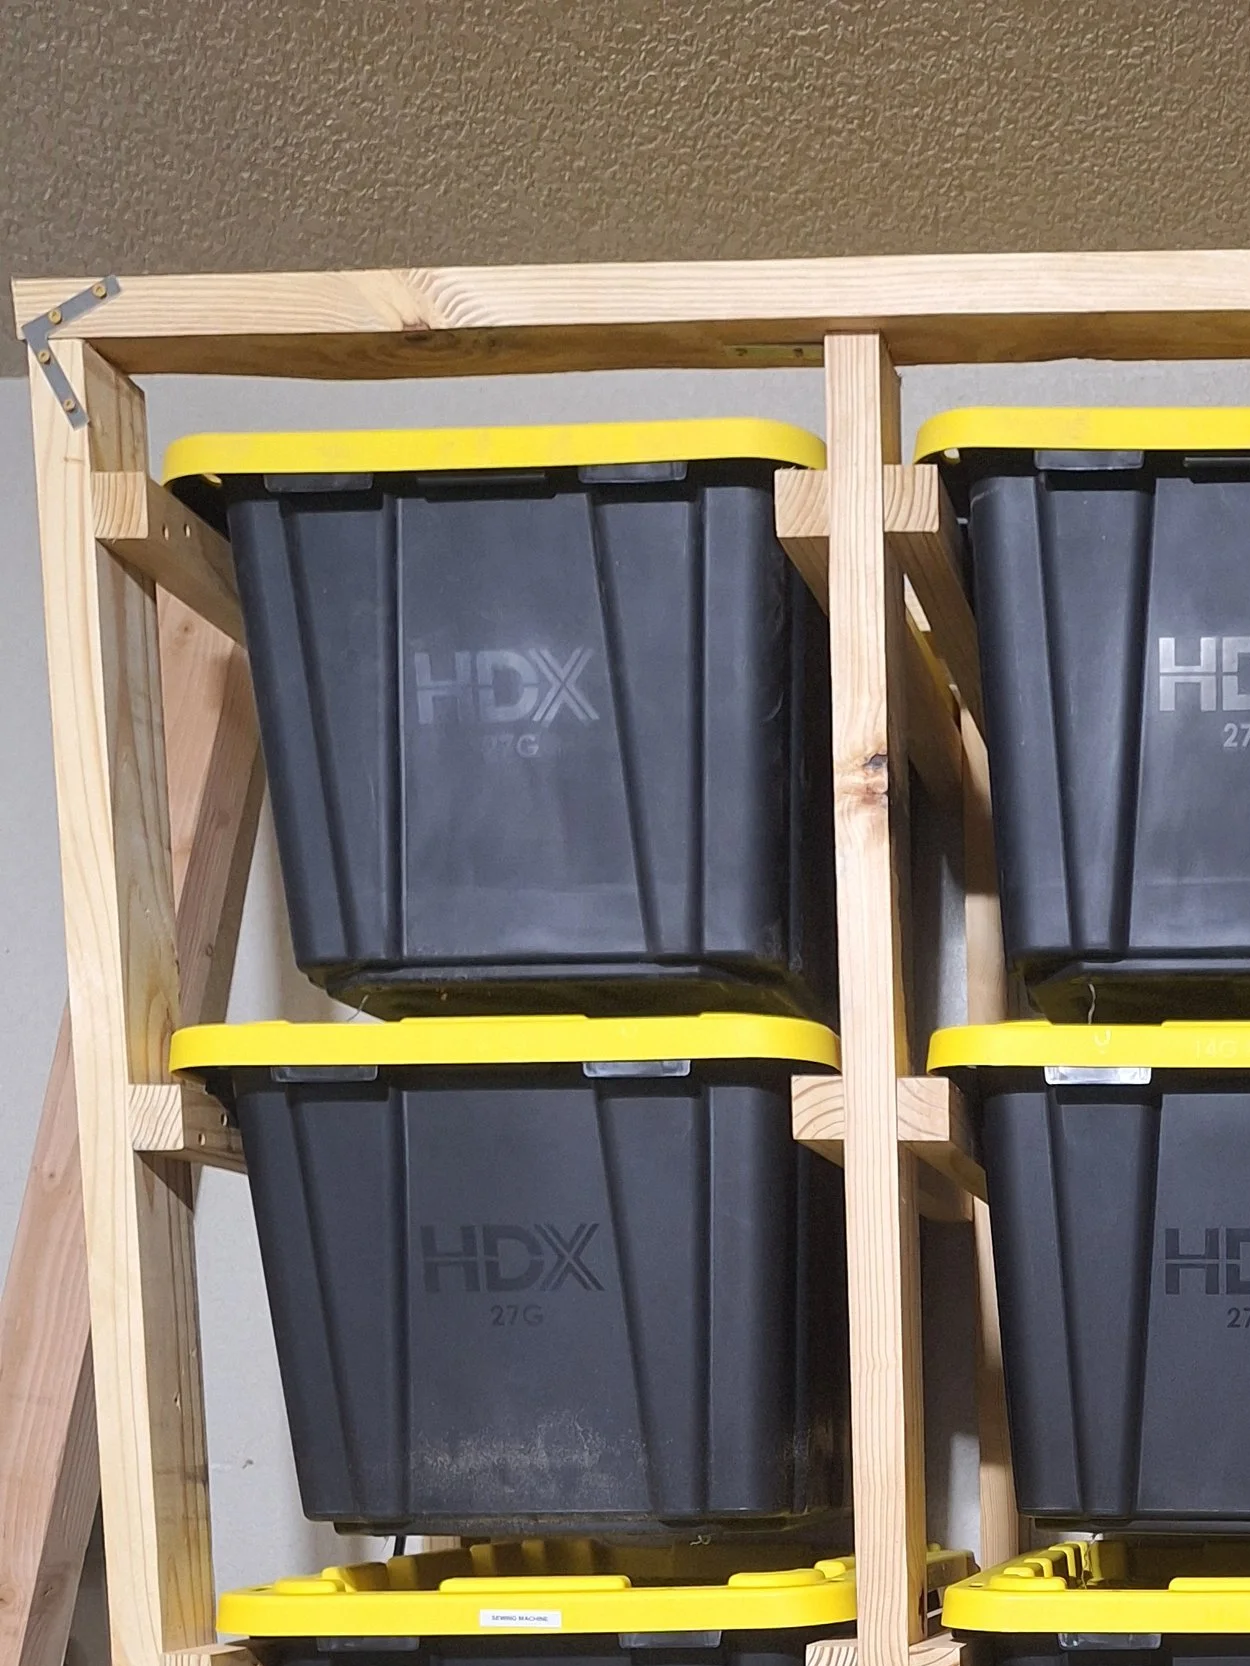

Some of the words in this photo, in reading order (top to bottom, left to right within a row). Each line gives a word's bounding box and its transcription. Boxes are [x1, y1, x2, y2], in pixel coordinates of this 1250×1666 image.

[413, 648, 600, 727] HDX
[420, 1222, 606, 1293] HDX
[491, 1304, 544, 1327] 27G
